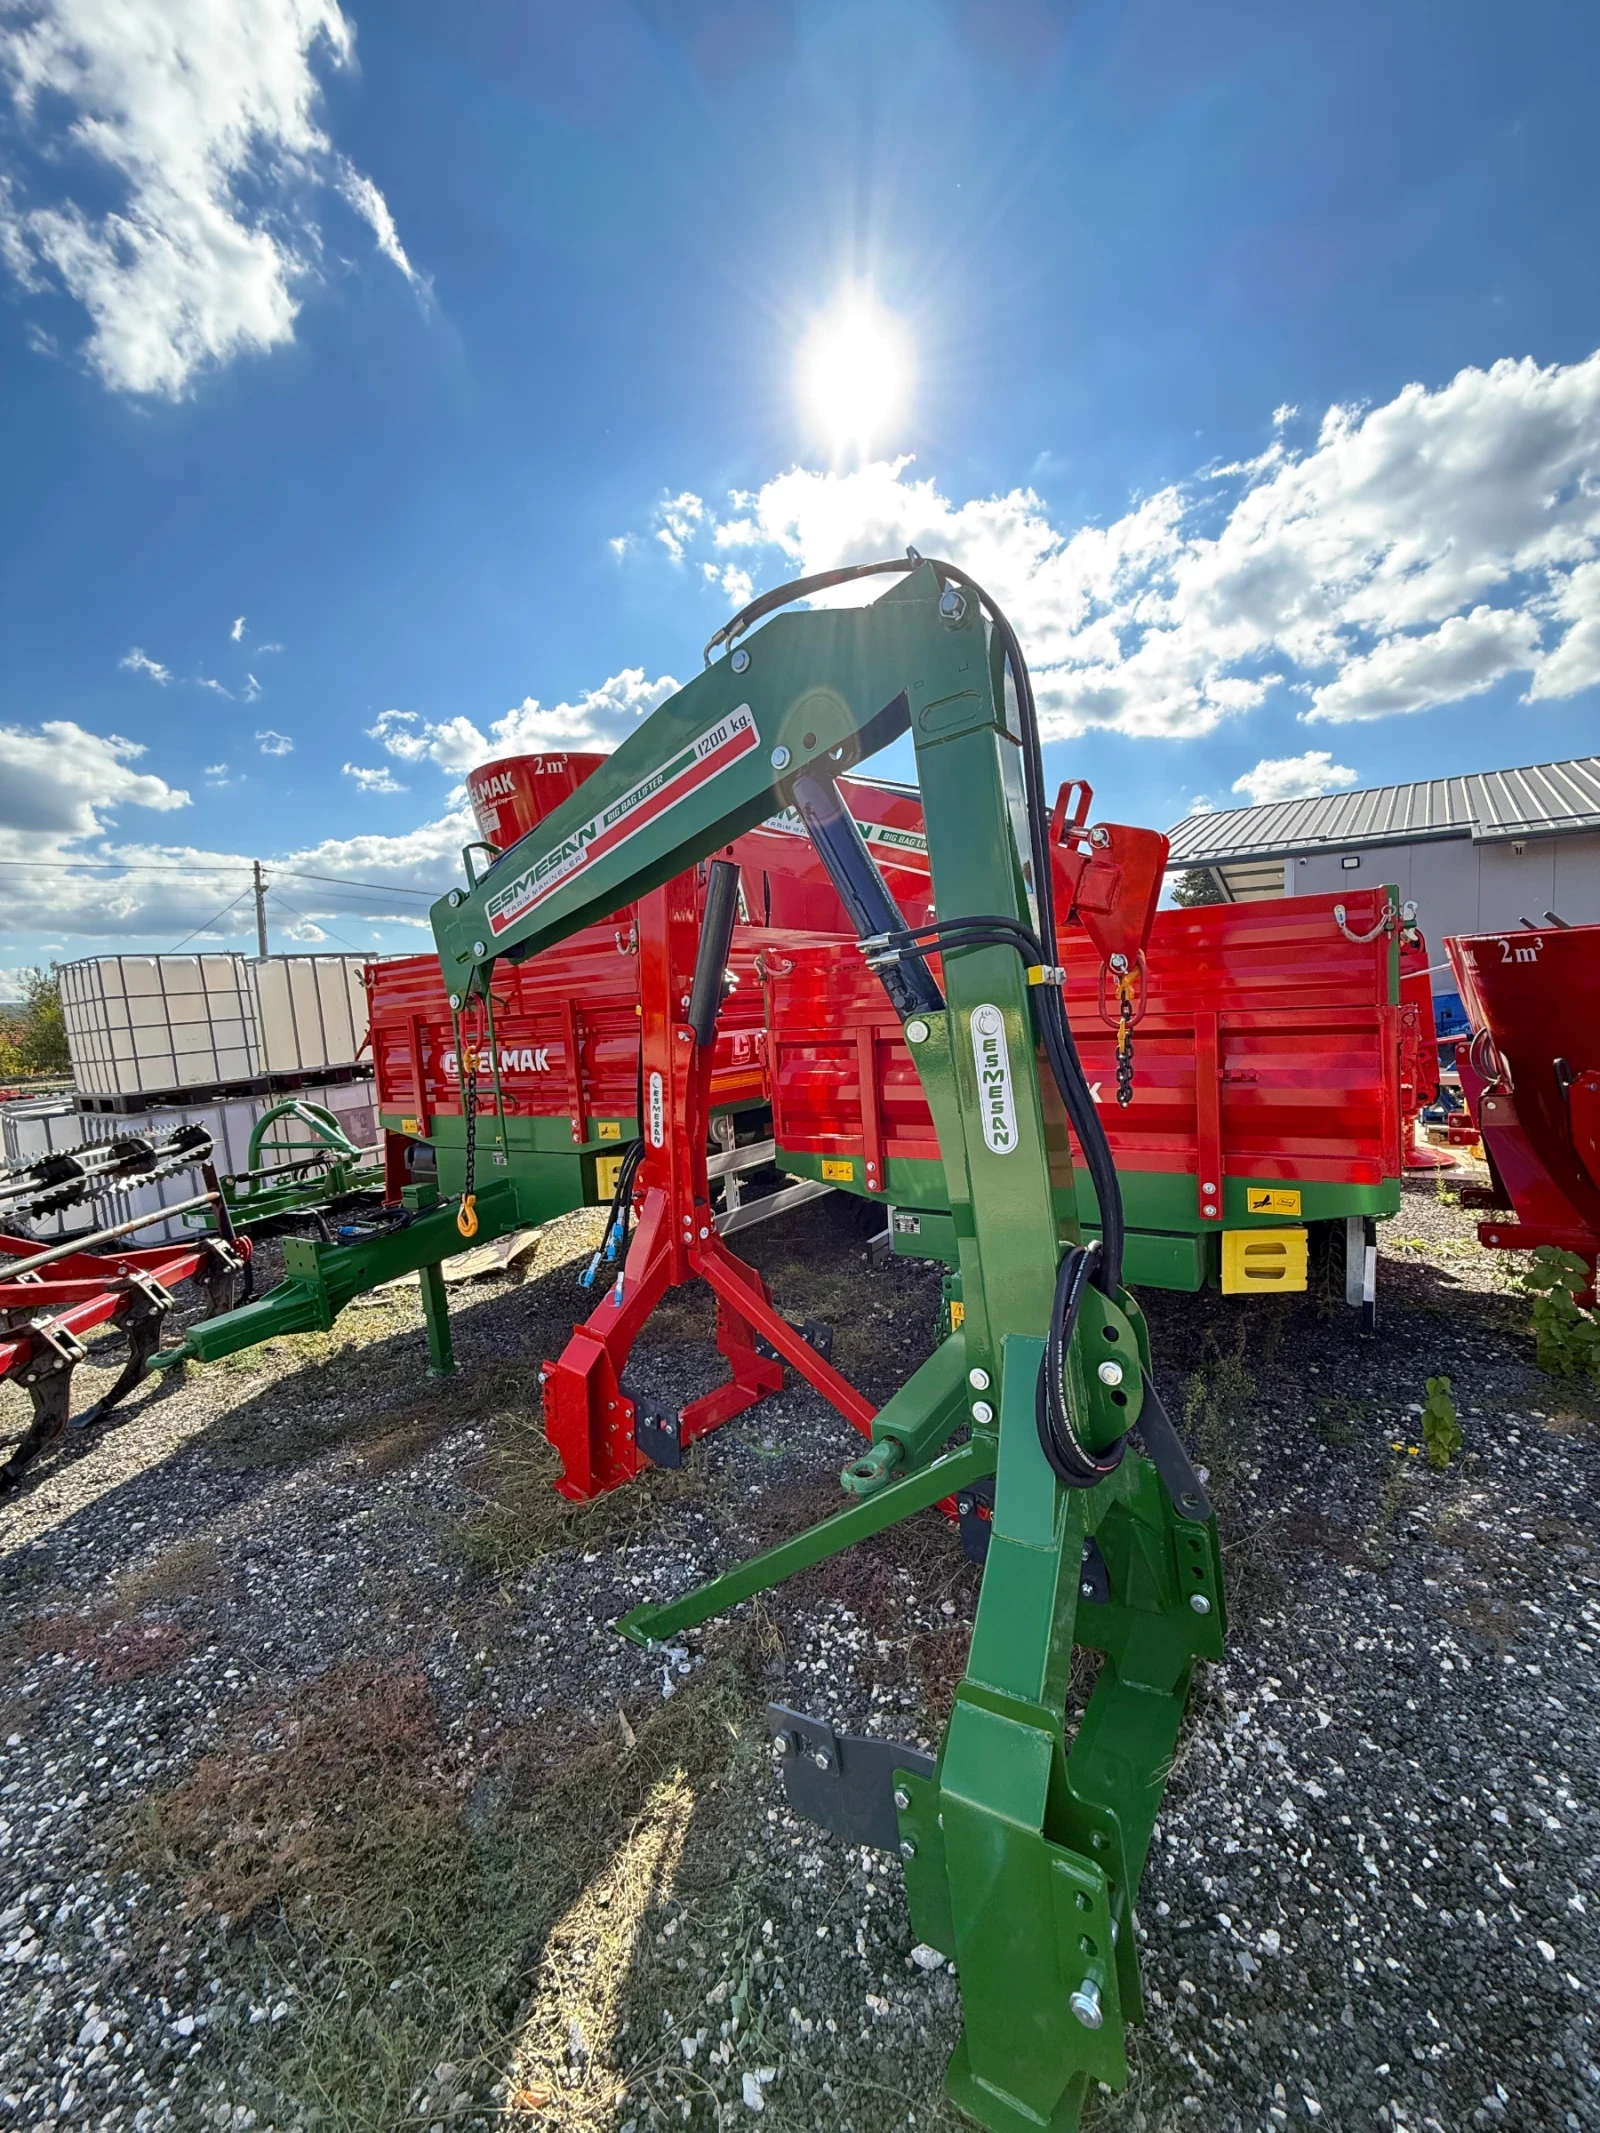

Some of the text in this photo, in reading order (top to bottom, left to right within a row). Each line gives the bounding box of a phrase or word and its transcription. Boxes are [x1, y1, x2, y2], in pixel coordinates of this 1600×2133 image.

[698, 715, 751, 757] 1200 kg.
[607, 774, 664, 823] BIG BAG LIFTER
[883, 832, 898, 842] BIG
[898, 835, 917, 846] BAG
[488, 821, 598, 918] ESMESAN
[982, 1038, 1010, 1146] ESMESAN
